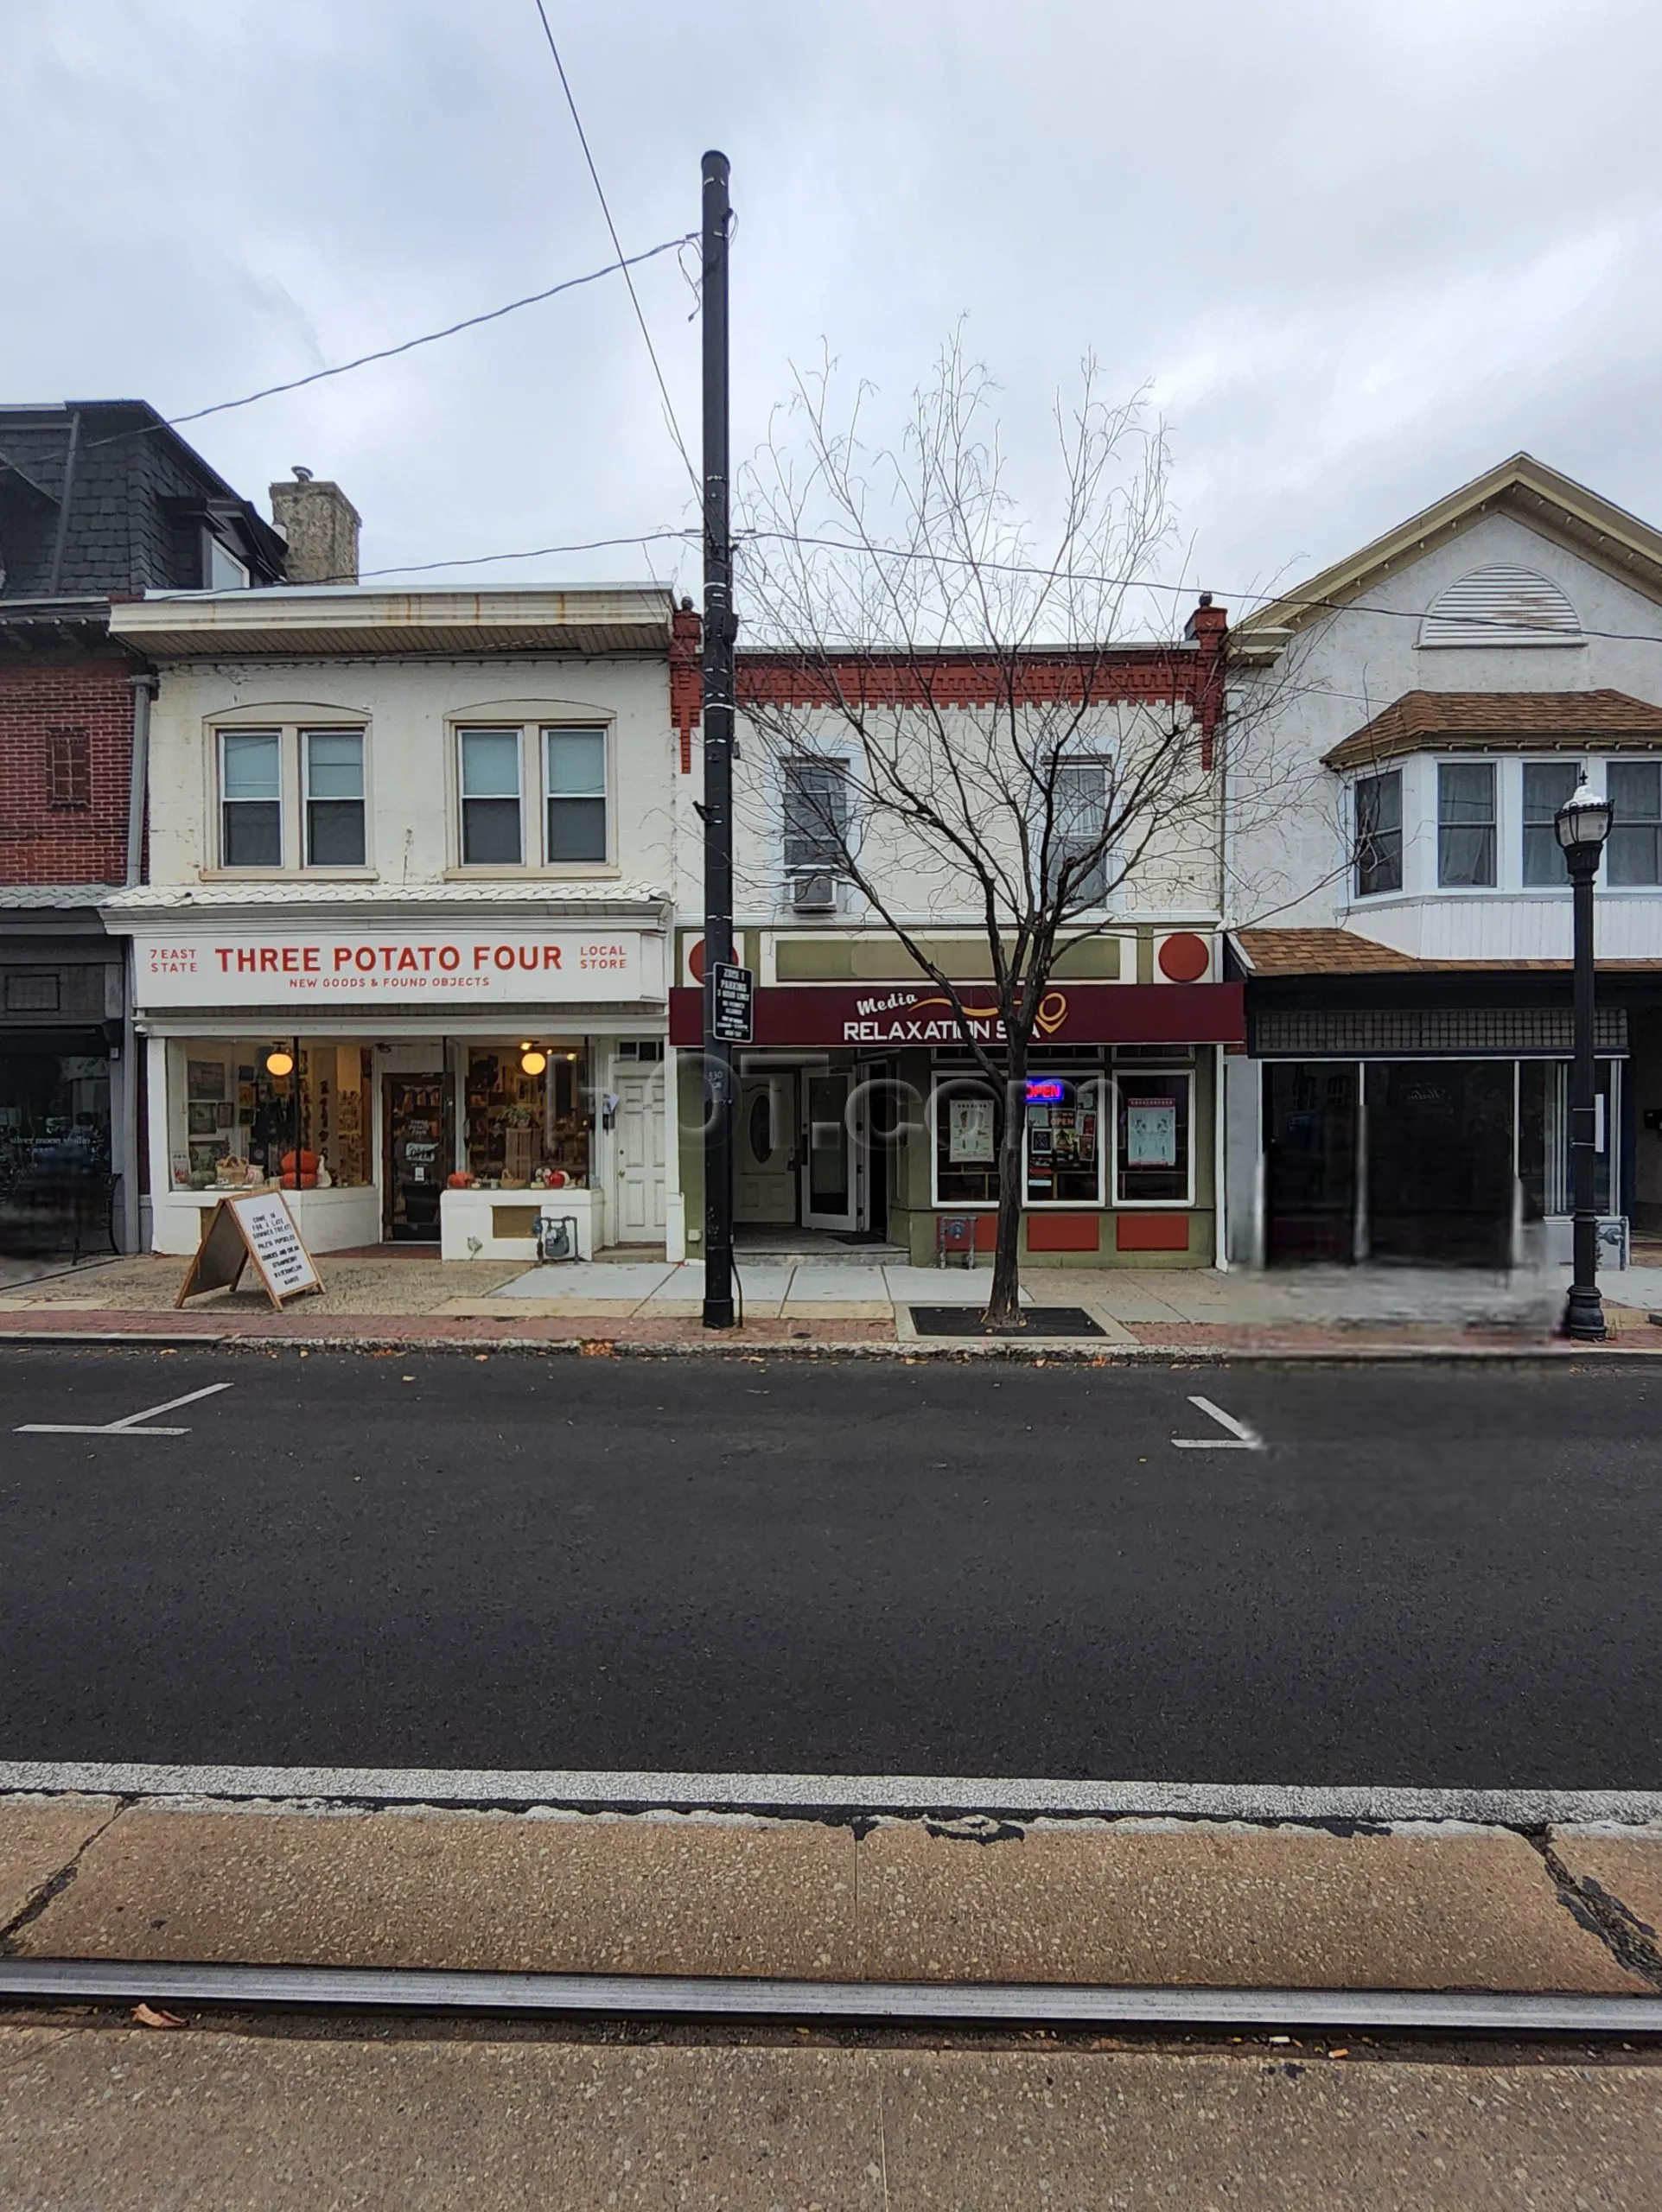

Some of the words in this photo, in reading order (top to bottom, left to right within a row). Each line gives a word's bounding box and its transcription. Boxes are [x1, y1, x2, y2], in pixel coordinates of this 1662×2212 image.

[161, 948, 197, 959] EAST
[580, 945, 627, 957] LOCAL
[215, 947, 321, 973] THREE
[334, 945, 461, 972] POTATO
[474, 945, 563, 971] FOUR
[580, 958, 627, 969] STORE
[150, 962, 198, 973] STATE
[290, 978, 317, 988] NEW
[322, 977, 366, 988] GOODS
[370, 978, 379, 987] &
[383, 977, 427, 987] FOUND
[431, 976, 490, 987] OBJECTS
[856, 993, 919, 1016] Media
[1050, 1117, 1074, 1126] OPEN
